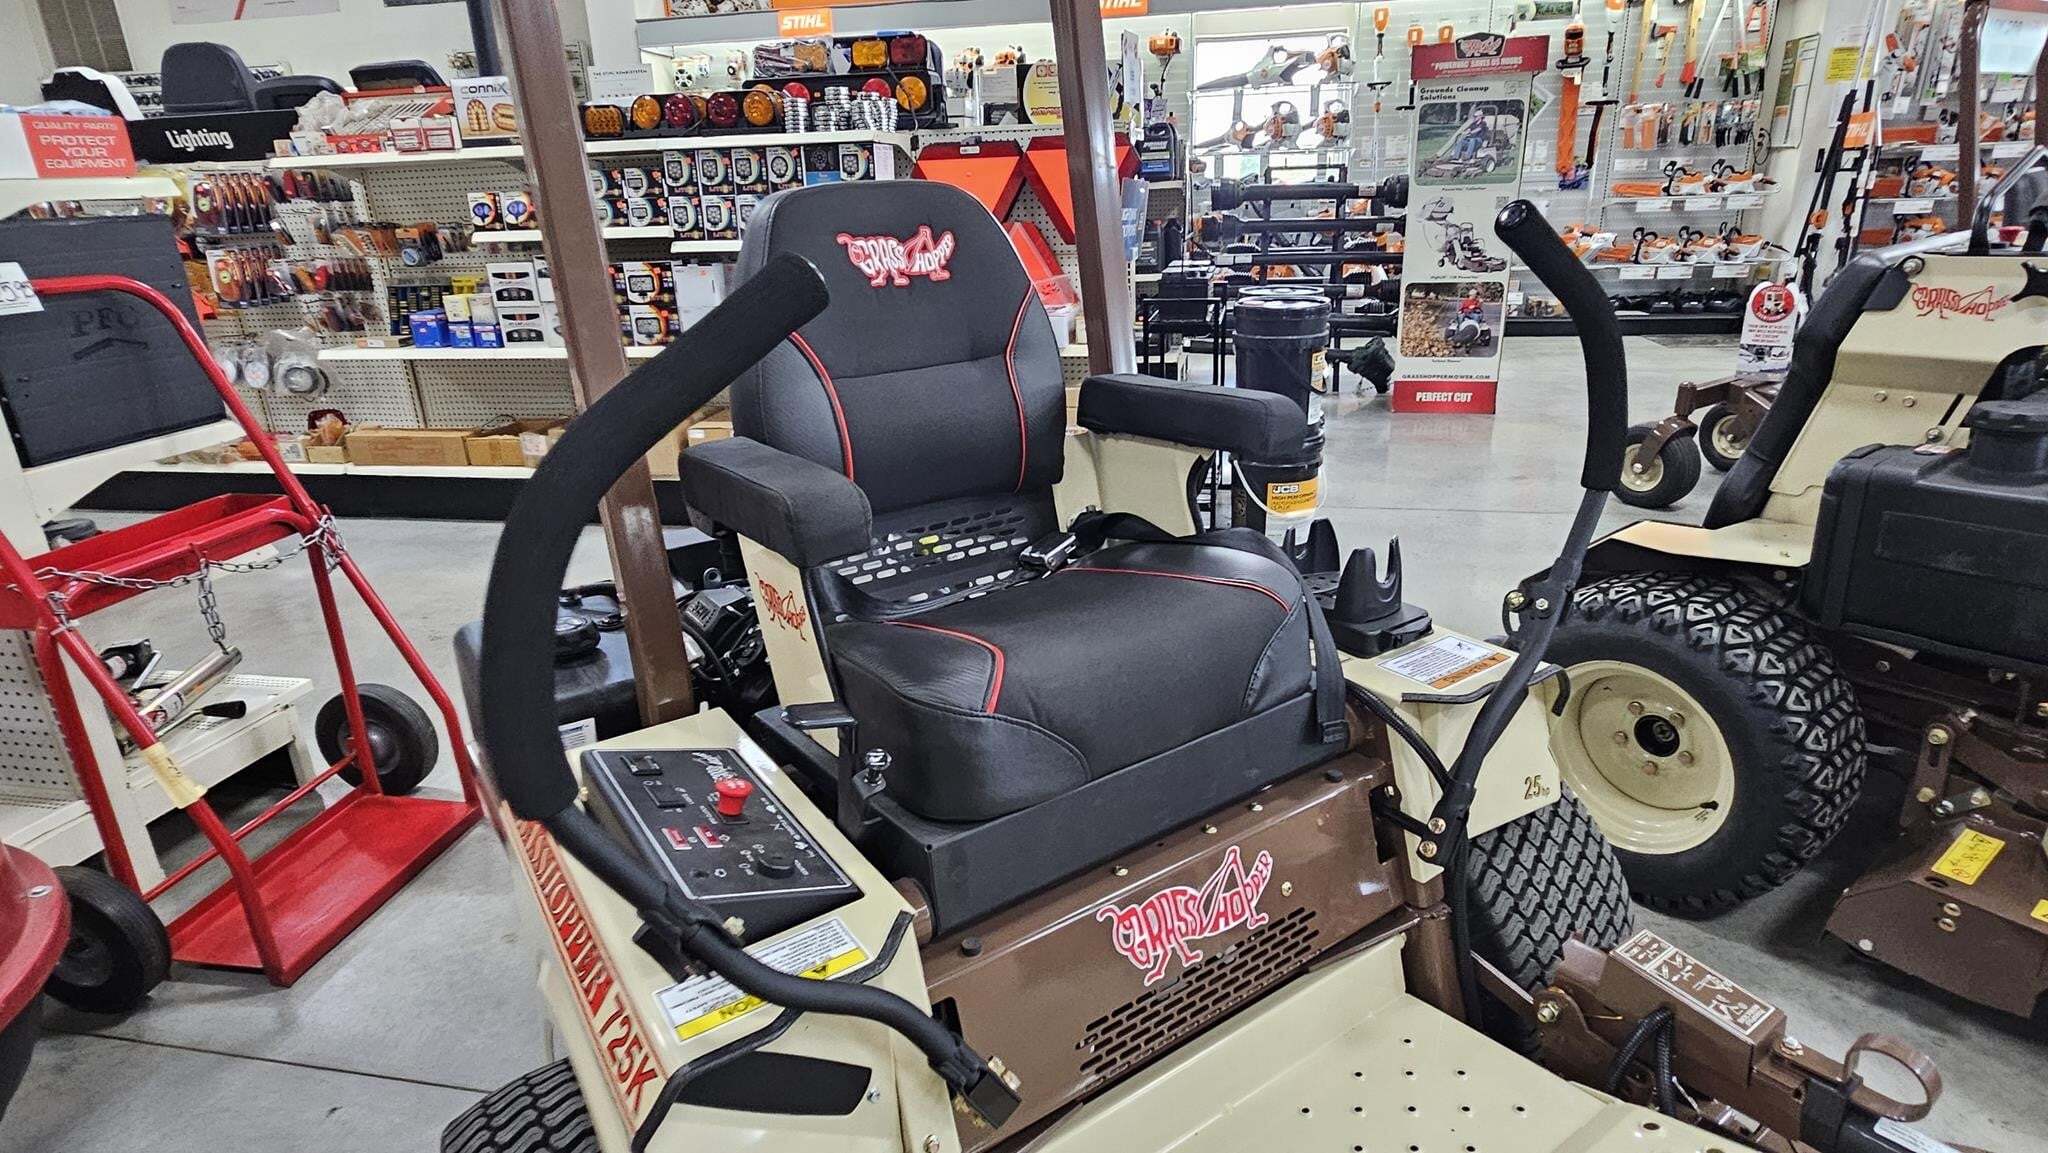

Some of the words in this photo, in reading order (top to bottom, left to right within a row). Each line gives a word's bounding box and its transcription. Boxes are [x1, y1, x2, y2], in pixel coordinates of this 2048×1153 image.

[782, 14, 827, 30] STIHL
[1420, 86, 1453, 94] Grounds
[1457, 86, 1489, 94] Cleanup
[32, 121, 81, 131] QUALITY
[39, 135, 118, 146] PROTECT
[165, 129, 234, 151] Lighting
[58, 147, 109, 158] YOUR
[44, 158, 129, 170] EQUIPMENT
[1415, 391, 1453, 403] PERFECT
[1453, 391, 1473, 403] CUT
[1272, 484, 1300, 494] JCB
[1110, 848, 1274, 968] GRASSHOPPER
[600, 992, 659, 1113] 725K
